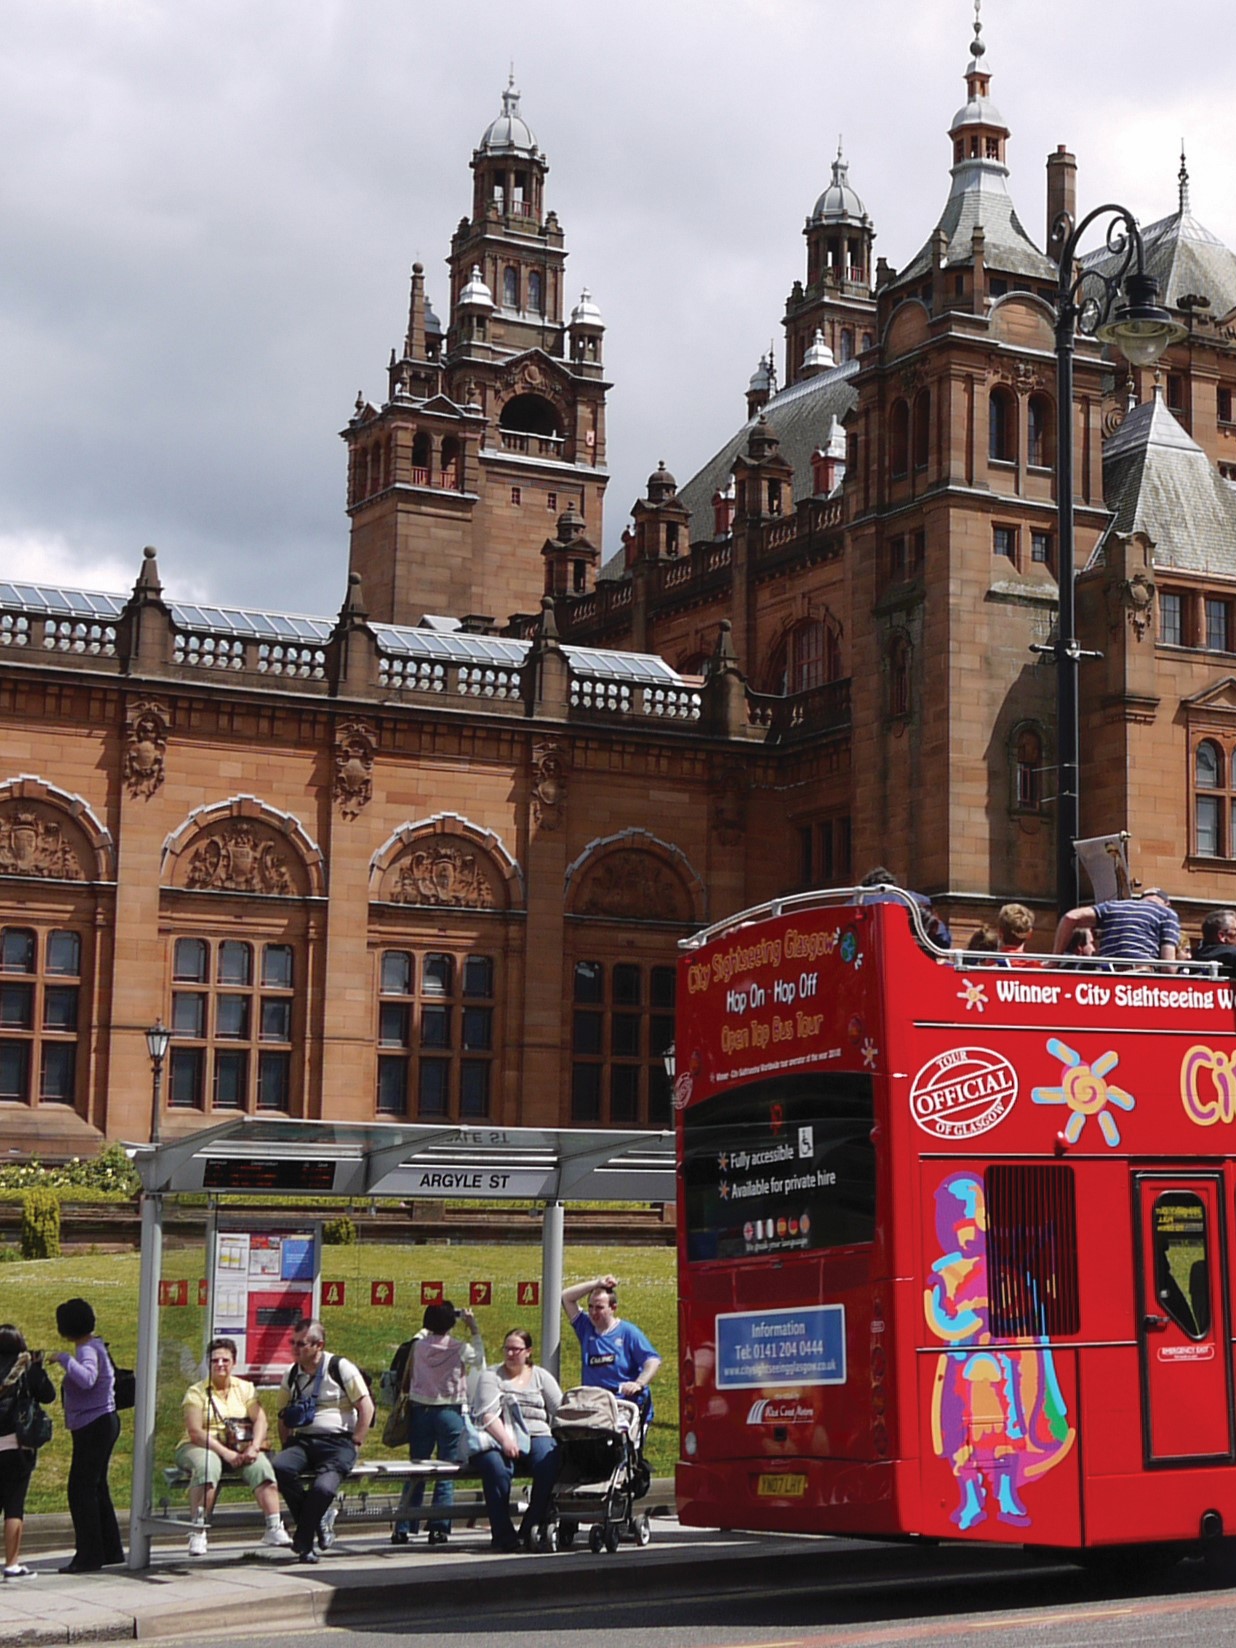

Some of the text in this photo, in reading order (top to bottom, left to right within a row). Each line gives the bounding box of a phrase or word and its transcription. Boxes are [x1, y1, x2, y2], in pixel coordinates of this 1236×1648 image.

[688, 929, 835, 994] City Sightseeing Glasgow
[727, 989, 747, 1015] Hop
[750, 984, 765, 1009] On
[774, 978, 796, 1005] Hop
[799, 973, 818, 998] Off
[996, 980, 1061, 1004] Winner
[1075, 983, 1111, 1009] City
[1115, 985, 1214, 1010] Sightseeing
[721, 1011, 824, 1055] Open Top Bus Tour
[936, 1050, 968, 1069] TOUR
[916, 1070, 1012, 1115] OFFICIAL
[936, 1101, 1005, 1135] OF GLASGOW
[730, 1144, 794, 1170] Fully accessible
[419, 1173, 510, 1189] ARGYLE ST
[732, 1169, 836, 1199] Available for private hire
[751, 1320, 805, 1338] Information
[734, 1340, 824, 1360] Tel: 0141 204 0444
